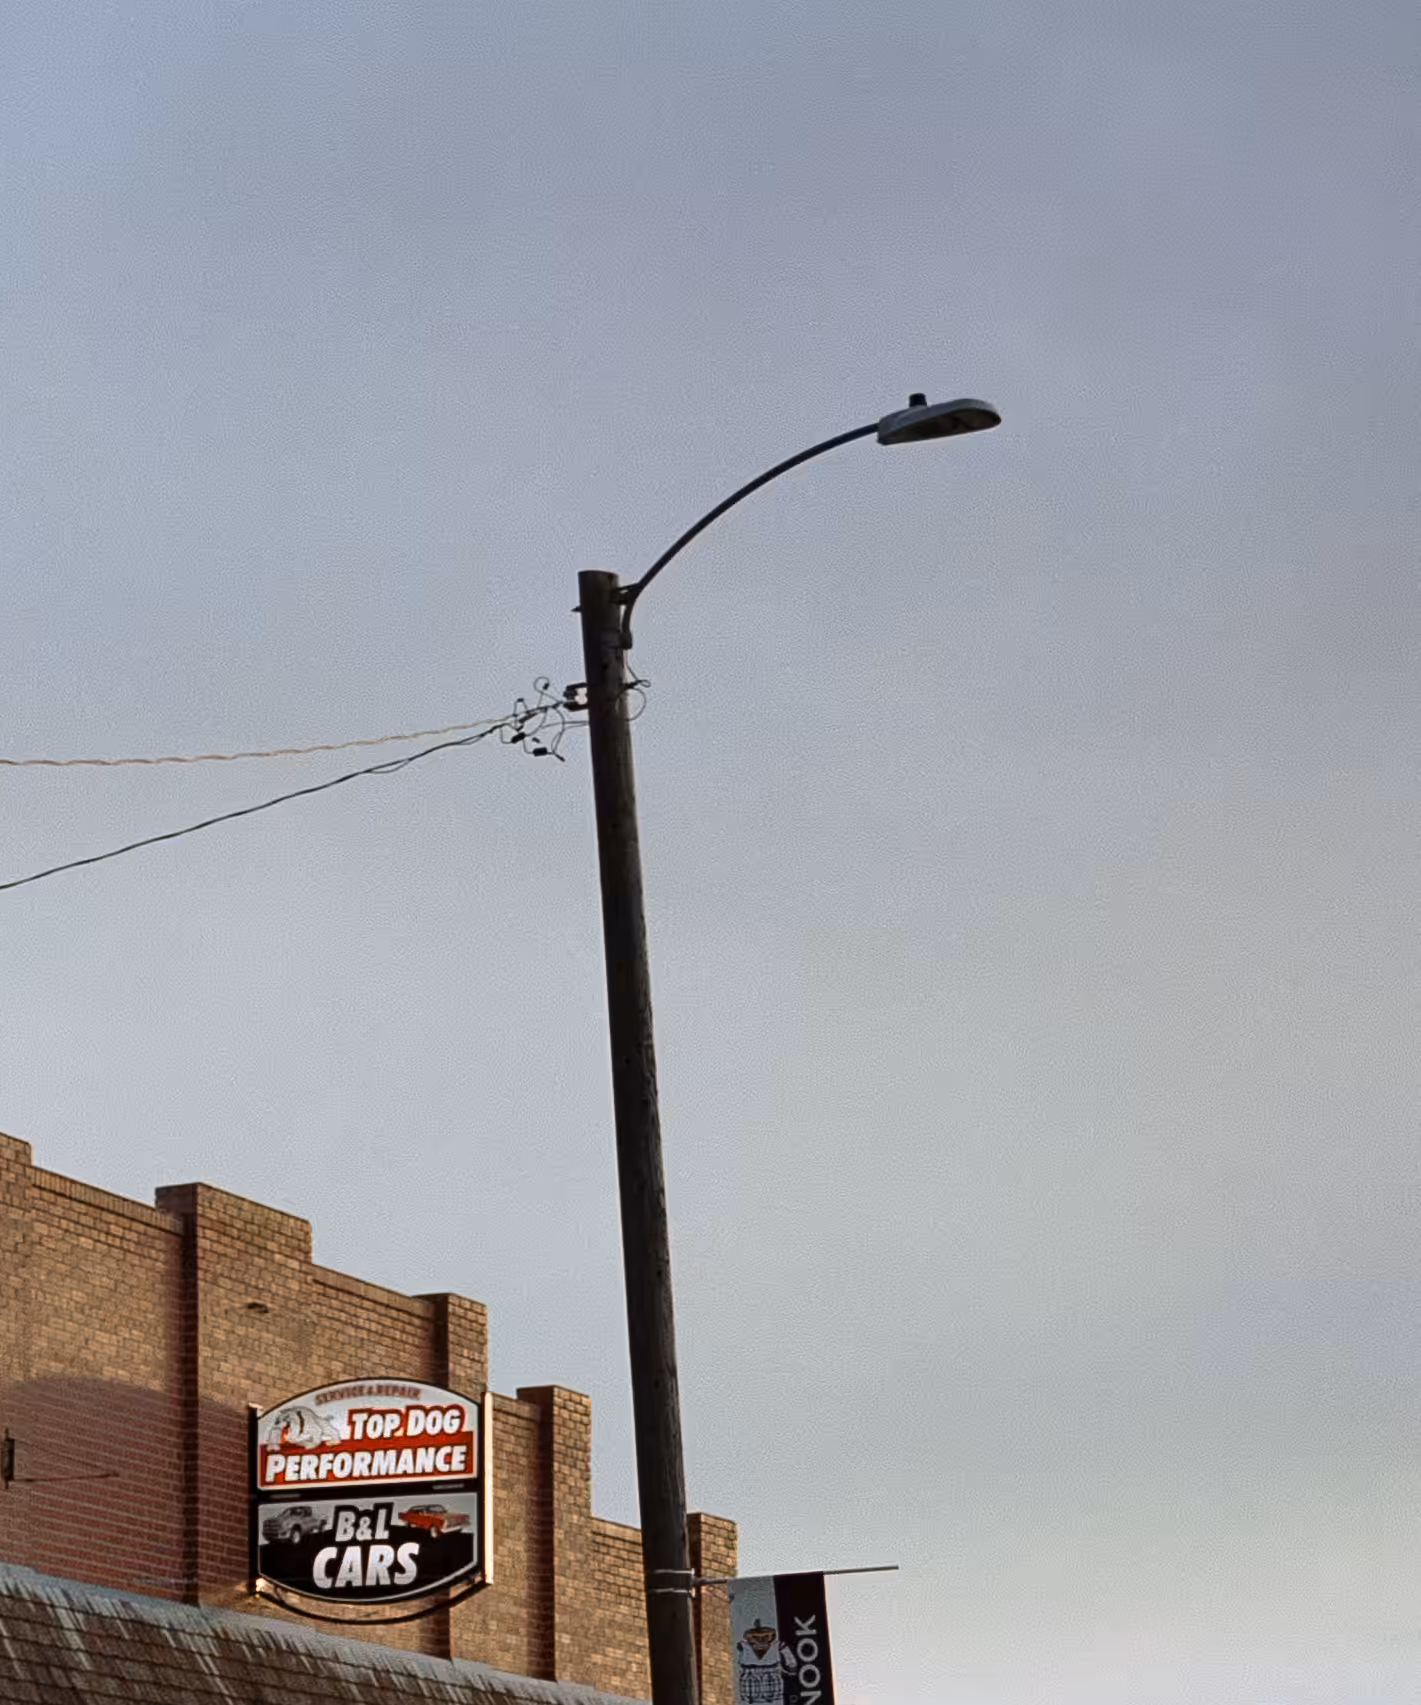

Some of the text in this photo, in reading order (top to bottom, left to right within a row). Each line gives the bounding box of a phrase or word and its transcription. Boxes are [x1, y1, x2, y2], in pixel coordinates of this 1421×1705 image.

[315, 1385, 363, 1406] SERVICE
[377, 1385, 421, 1400] REPAIR
[351, 1408, 461, 1440] TOP DOG
[264, 1445, 467, 1483] PERFORMANCE
[335, 1508, 390, 1543] B&L
[312, 1542, 420, 1590] CARS
